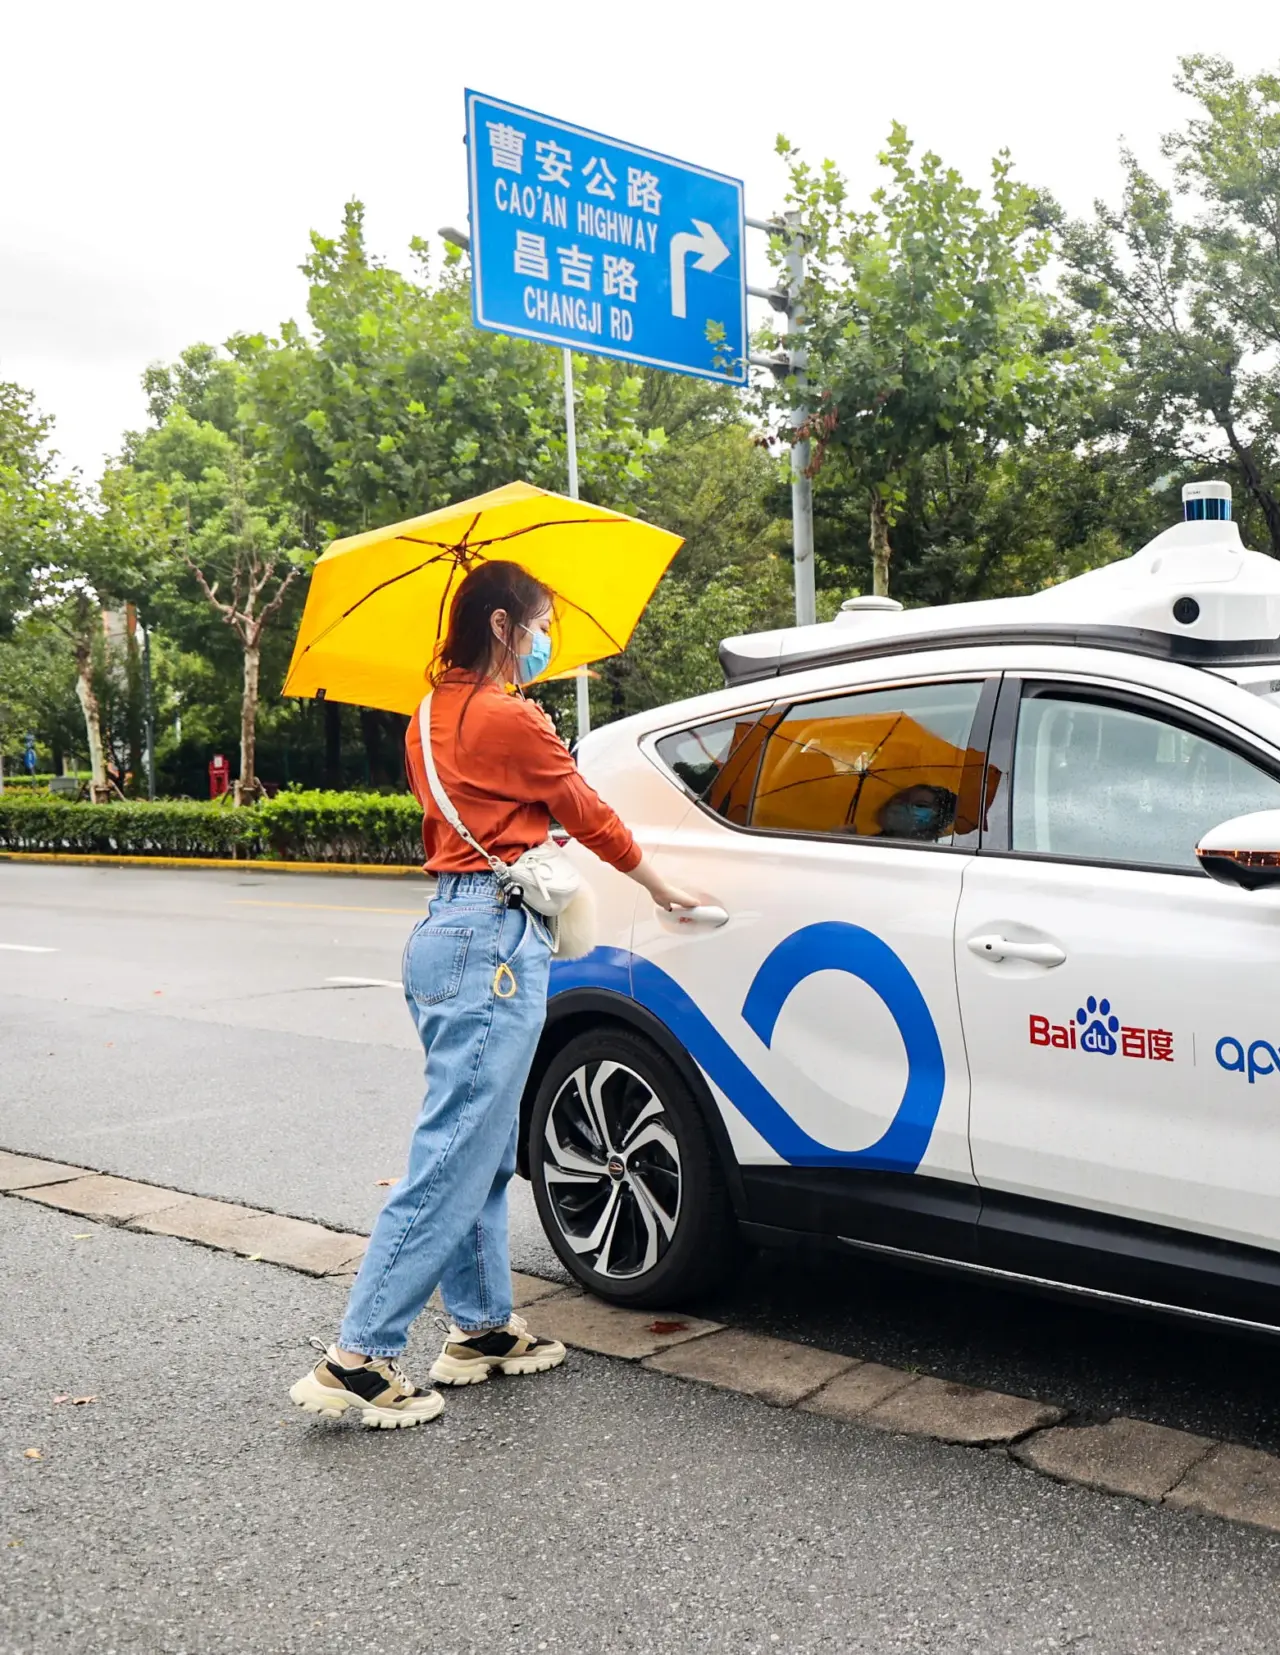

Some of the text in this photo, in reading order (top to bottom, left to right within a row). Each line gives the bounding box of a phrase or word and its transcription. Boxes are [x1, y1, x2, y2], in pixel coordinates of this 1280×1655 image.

[485, 120, 663, 216] 曹安公路
[494, 178, 658, 254] CAO'AN HIGHWAY
[513, 229, 639, 303] 昌吉路
[523, 285, 633, 342] CHANGJI RD
